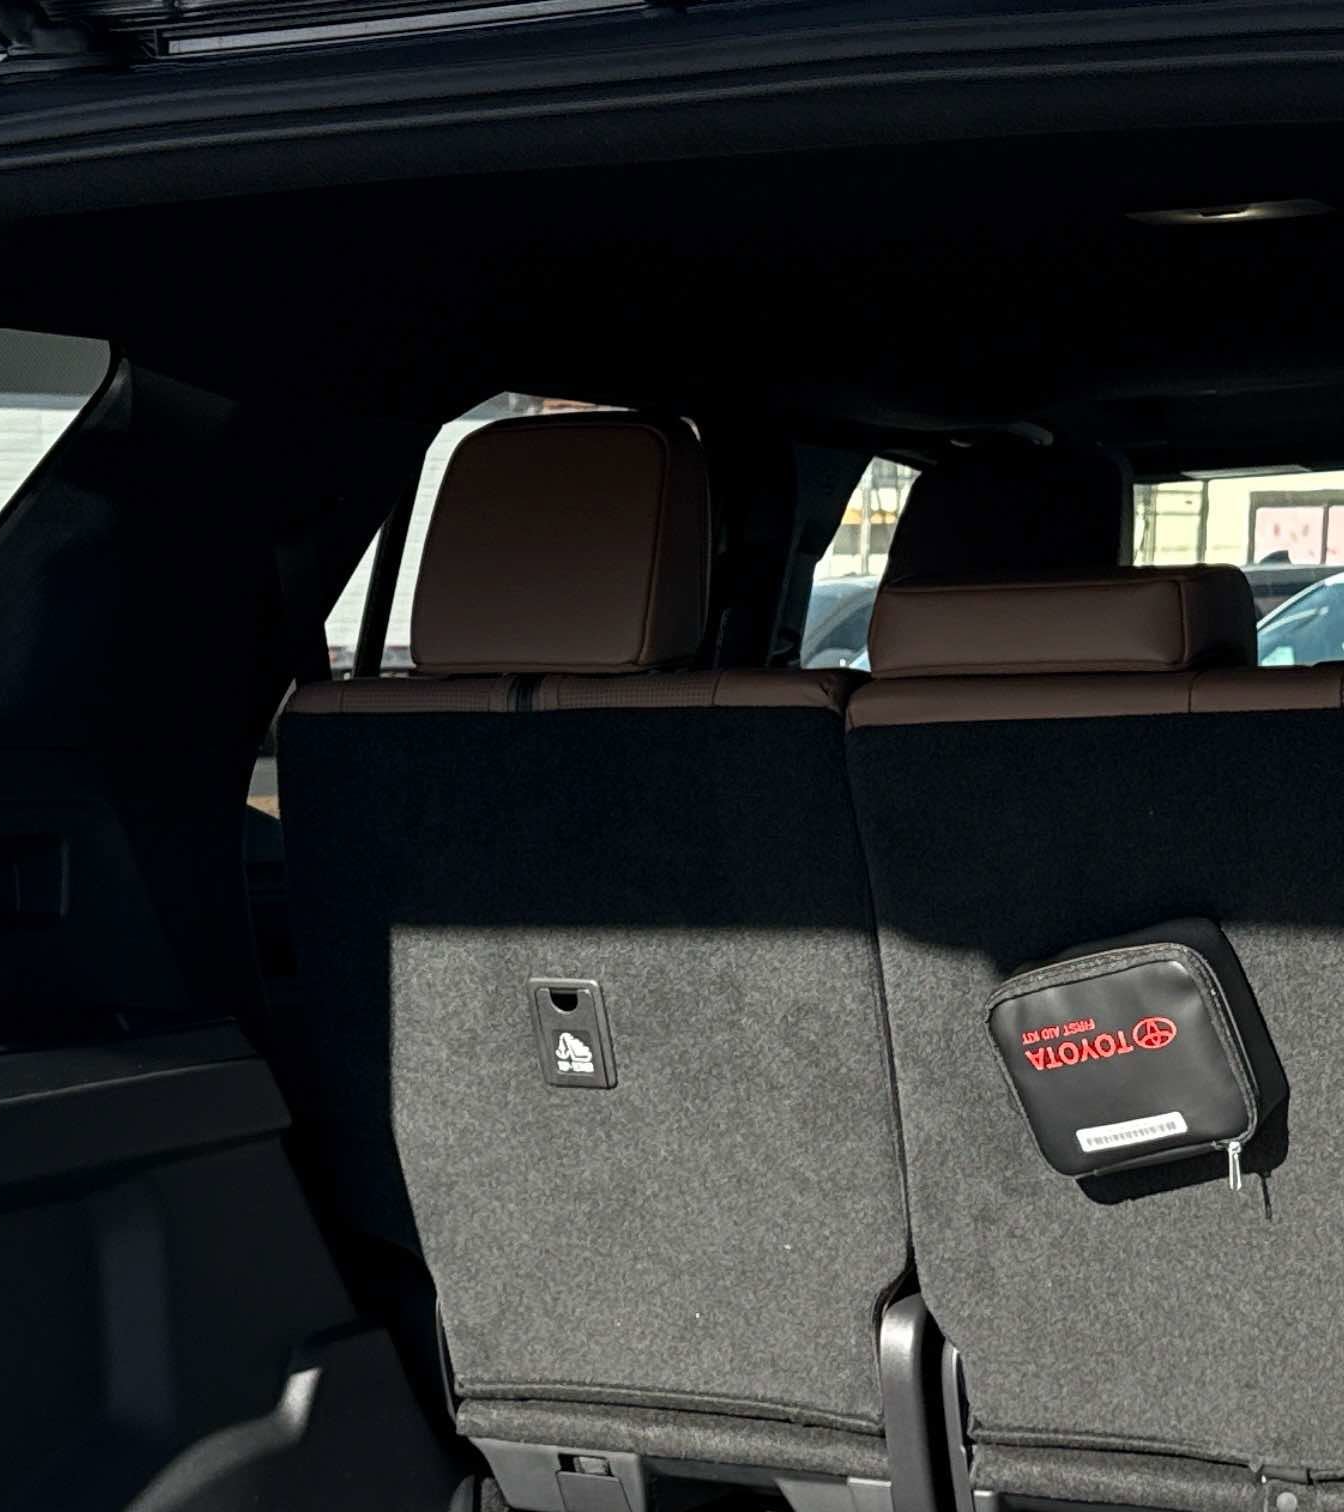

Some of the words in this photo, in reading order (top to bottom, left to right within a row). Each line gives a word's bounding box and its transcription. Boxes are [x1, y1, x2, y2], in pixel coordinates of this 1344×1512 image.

[1042, 1026, 1060, 1041] AID
[1063, 1019, 1095, 1037] FIRST
[1022, 1031, 1041, 1045] KIT
[1024, 1031, 1134, 1070] TOYOTA
